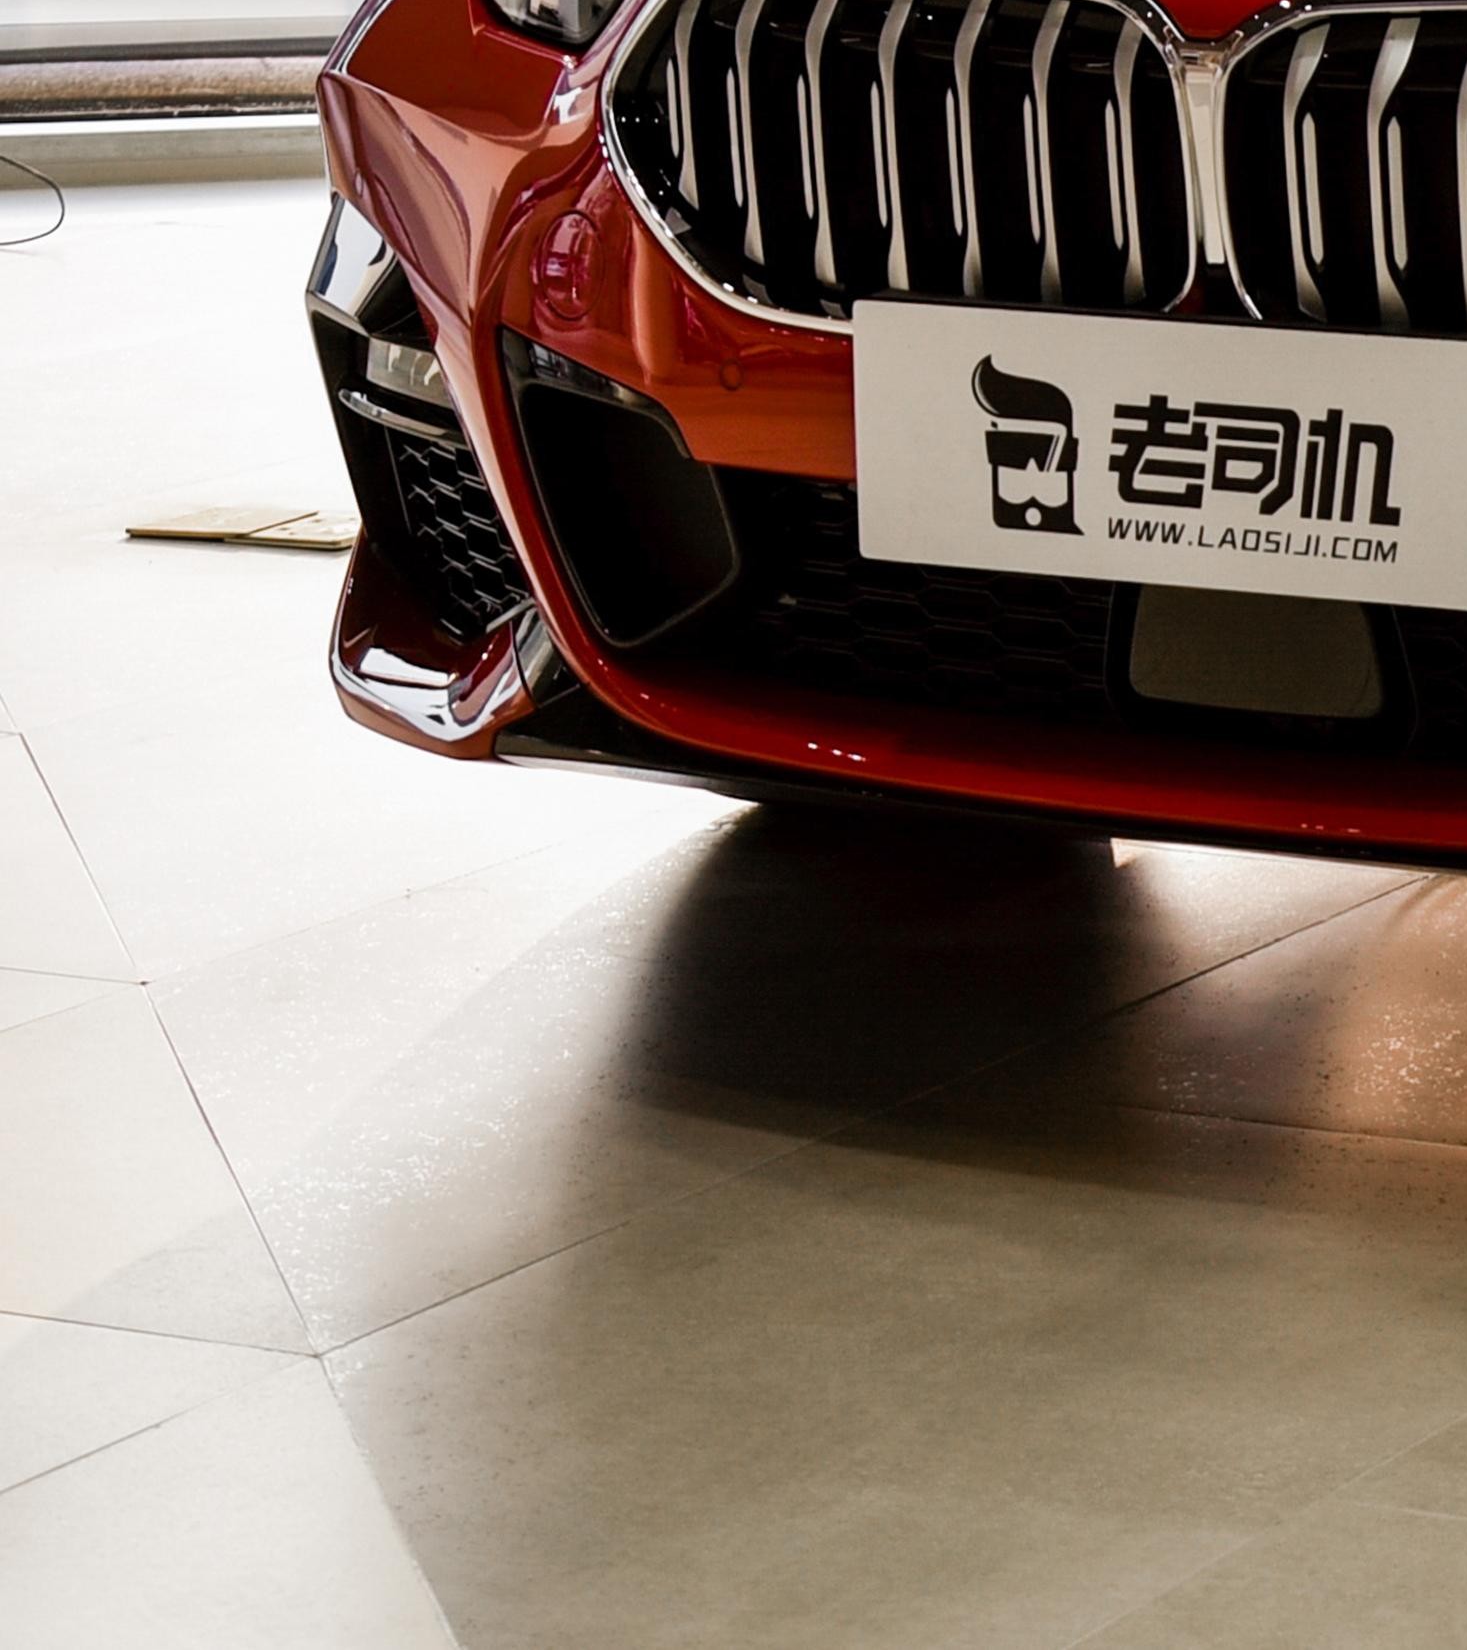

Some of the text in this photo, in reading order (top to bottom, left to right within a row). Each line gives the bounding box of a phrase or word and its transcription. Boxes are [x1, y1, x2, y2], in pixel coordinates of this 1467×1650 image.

[1108, 394, 1401, 526] 老司机
[1107, 517, 1399, 563] WWW.LAOSIJI.COM
